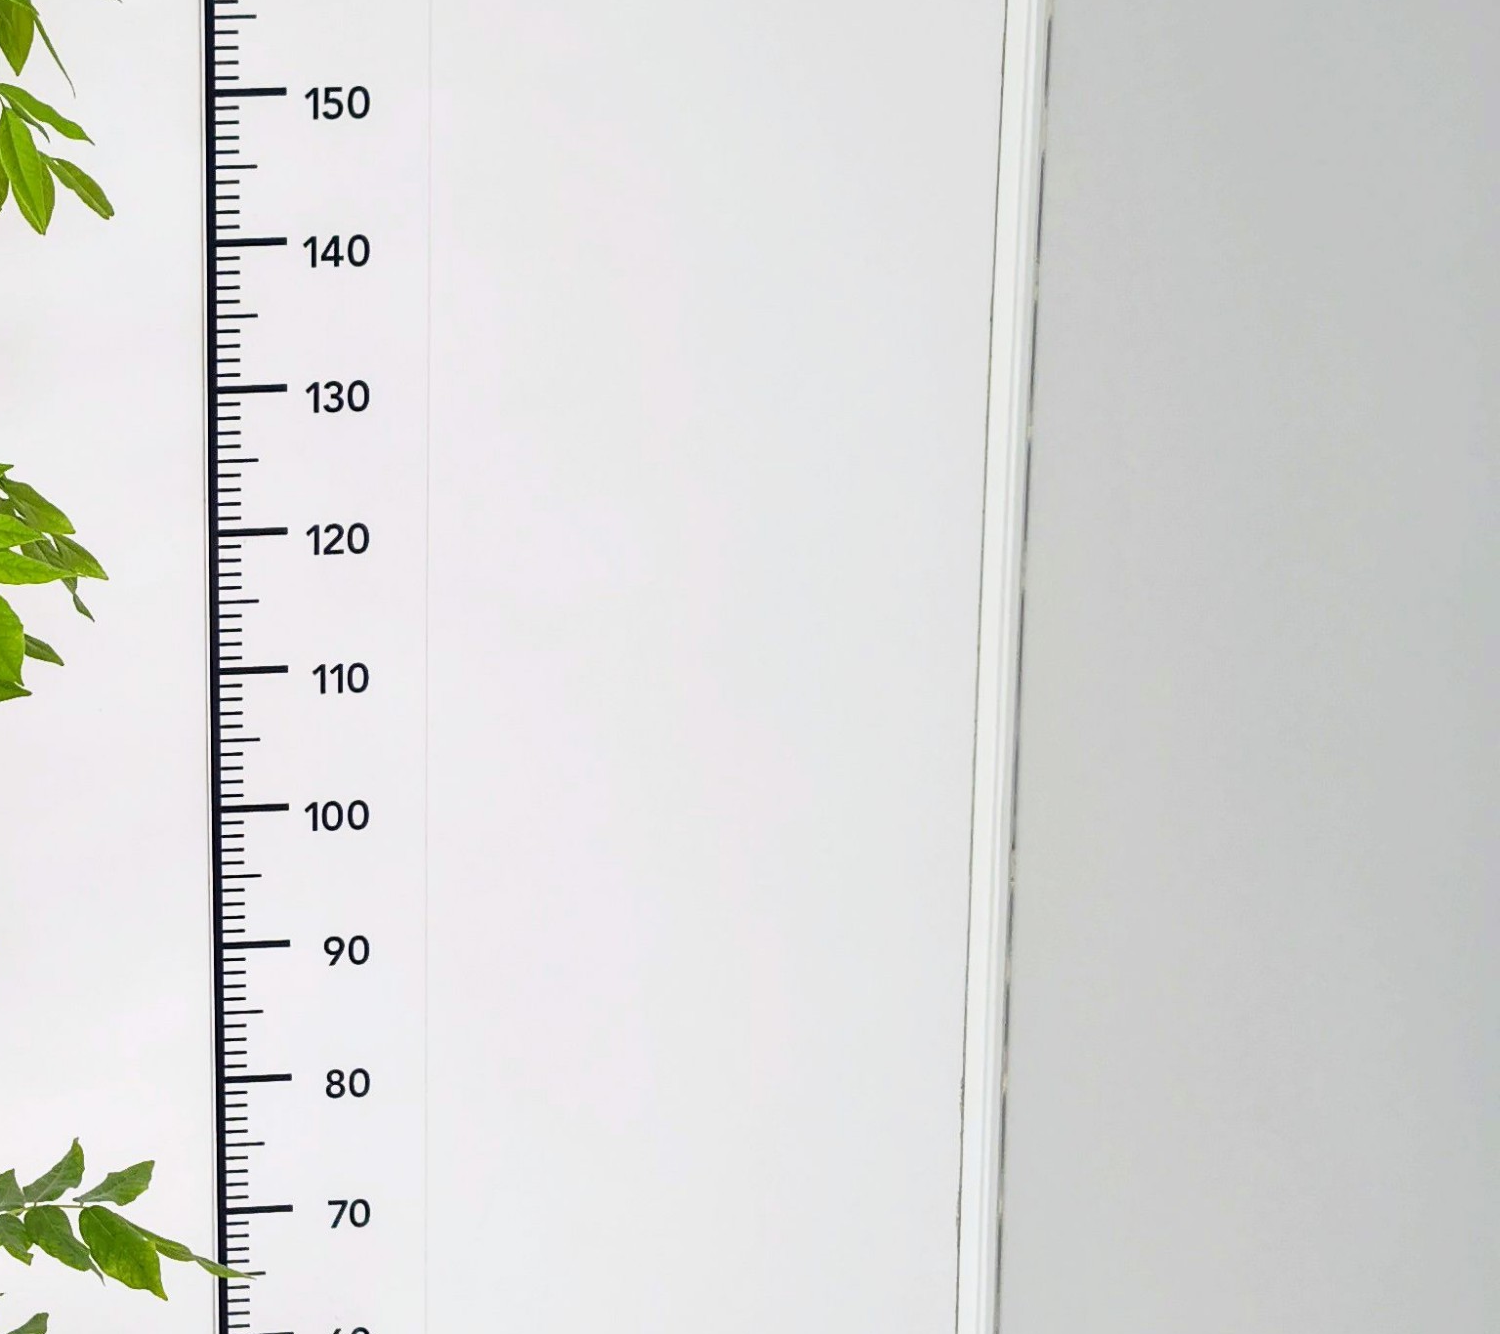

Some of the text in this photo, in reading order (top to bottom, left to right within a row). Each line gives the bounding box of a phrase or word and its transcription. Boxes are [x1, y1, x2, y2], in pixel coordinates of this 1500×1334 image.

[304, 85, 371, 120] 150
[302, 234, 371, 269] 140
[305, 379, 370, 414] 130
[306, 522, 370, 556] 120
[312, 662, 370, 695] 110
[304, 799, 370, 832] 100
[323, 935, 370, 967] 90
[325, 1067, 371, 1099] 80
[327, 1198, 371, 1229] 70
